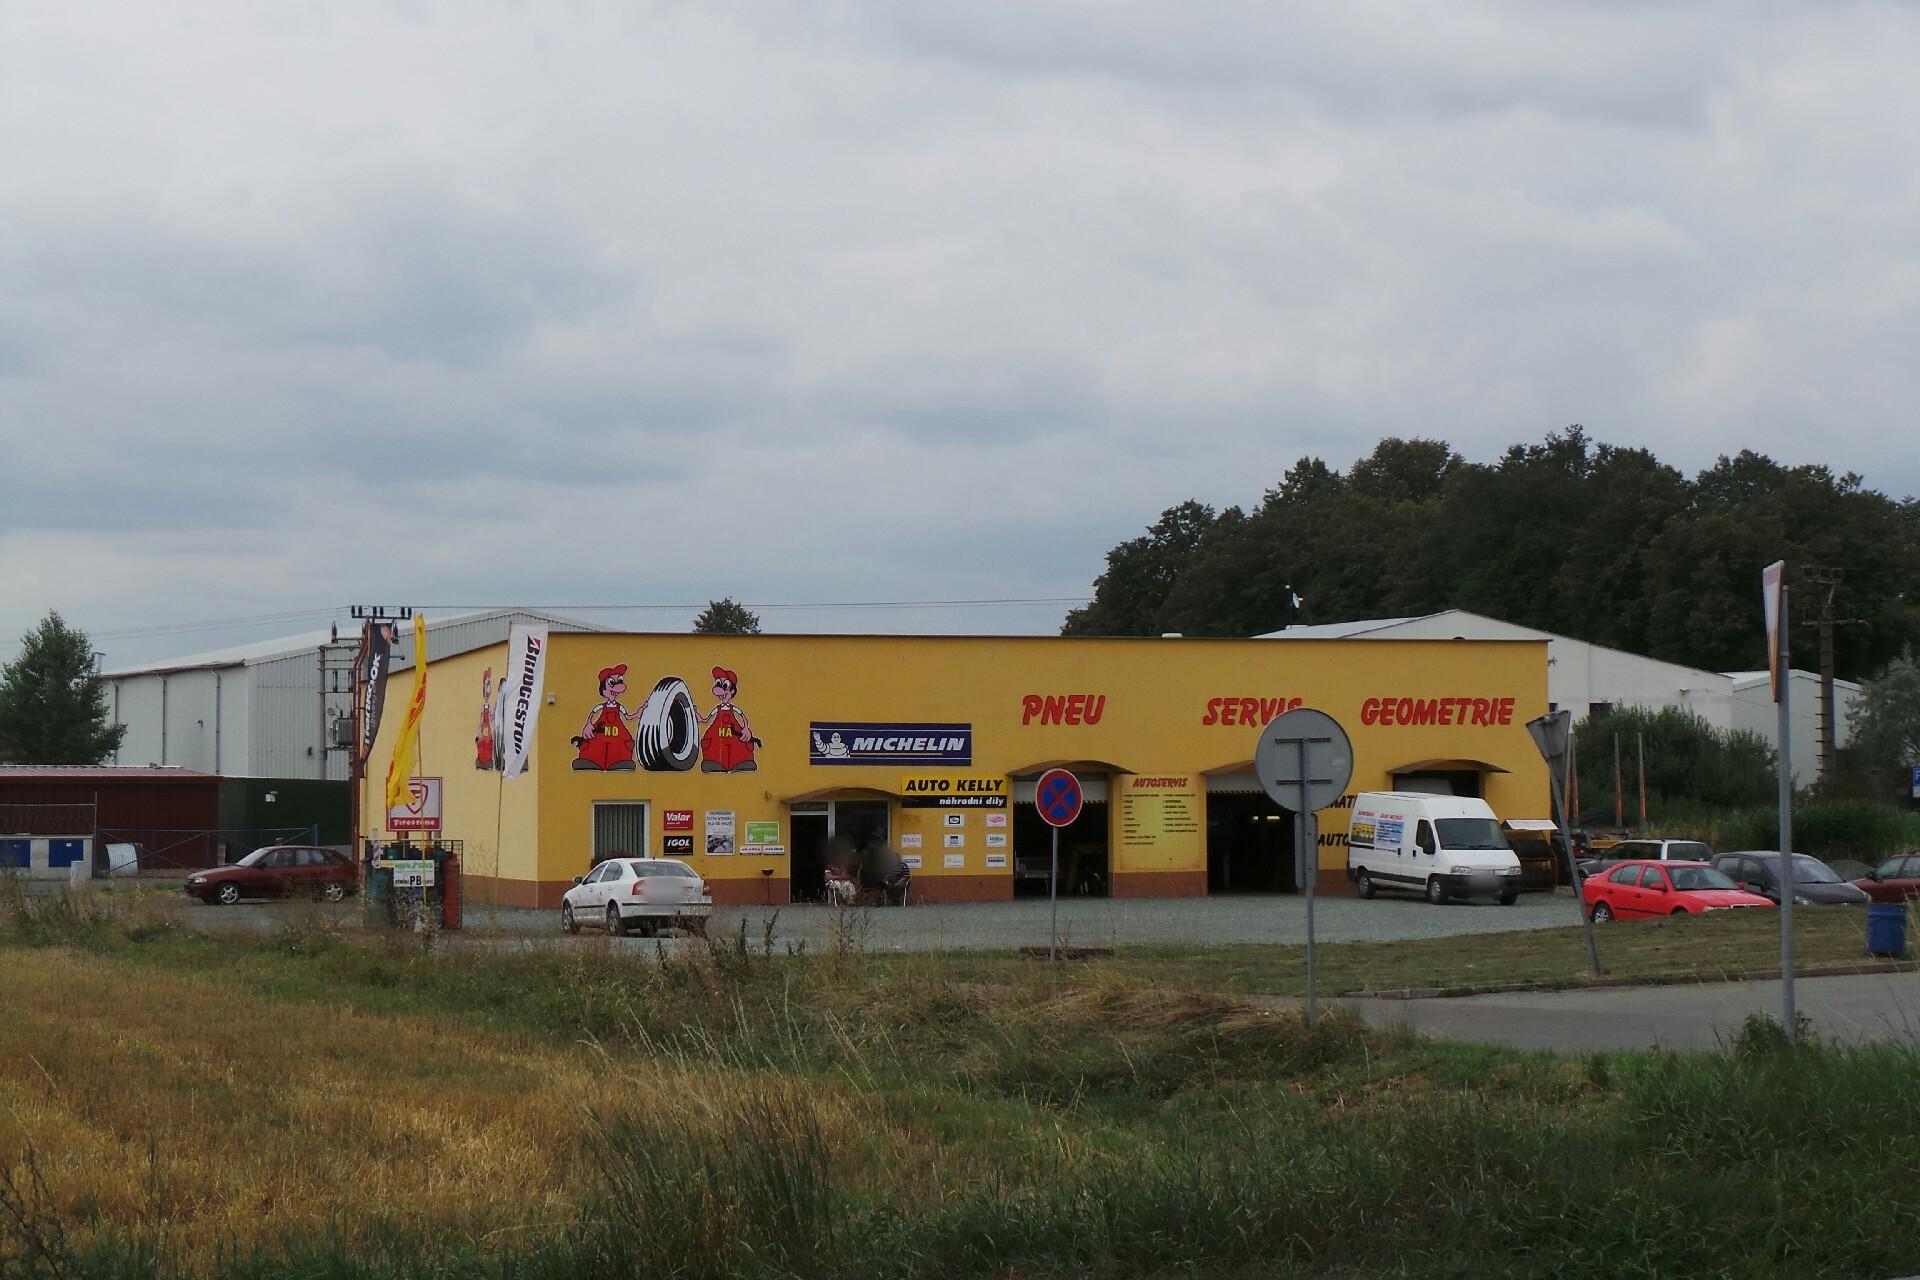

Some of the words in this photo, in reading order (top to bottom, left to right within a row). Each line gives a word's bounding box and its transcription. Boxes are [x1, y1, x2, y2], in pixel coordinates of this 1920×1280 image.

[1022, 694, 1105, 726] PNEU
[1360, 697, 1516, 727] GEOMETRIE
[604, 726, 619, 737] NO
[852, 737, 965, 751] MICHELIN
[905, 779, 950, 792] AUTO
[956, 779, 1004, 792] KELLY
[1133, 778, 1188, 788] AUTOSERVIS
[939, 797, 982, 806] náhradní
[985, 797, 1004, 807] díly
[667, 838, 690, 847] IGOL
[409, 875, 422, 886] PB
